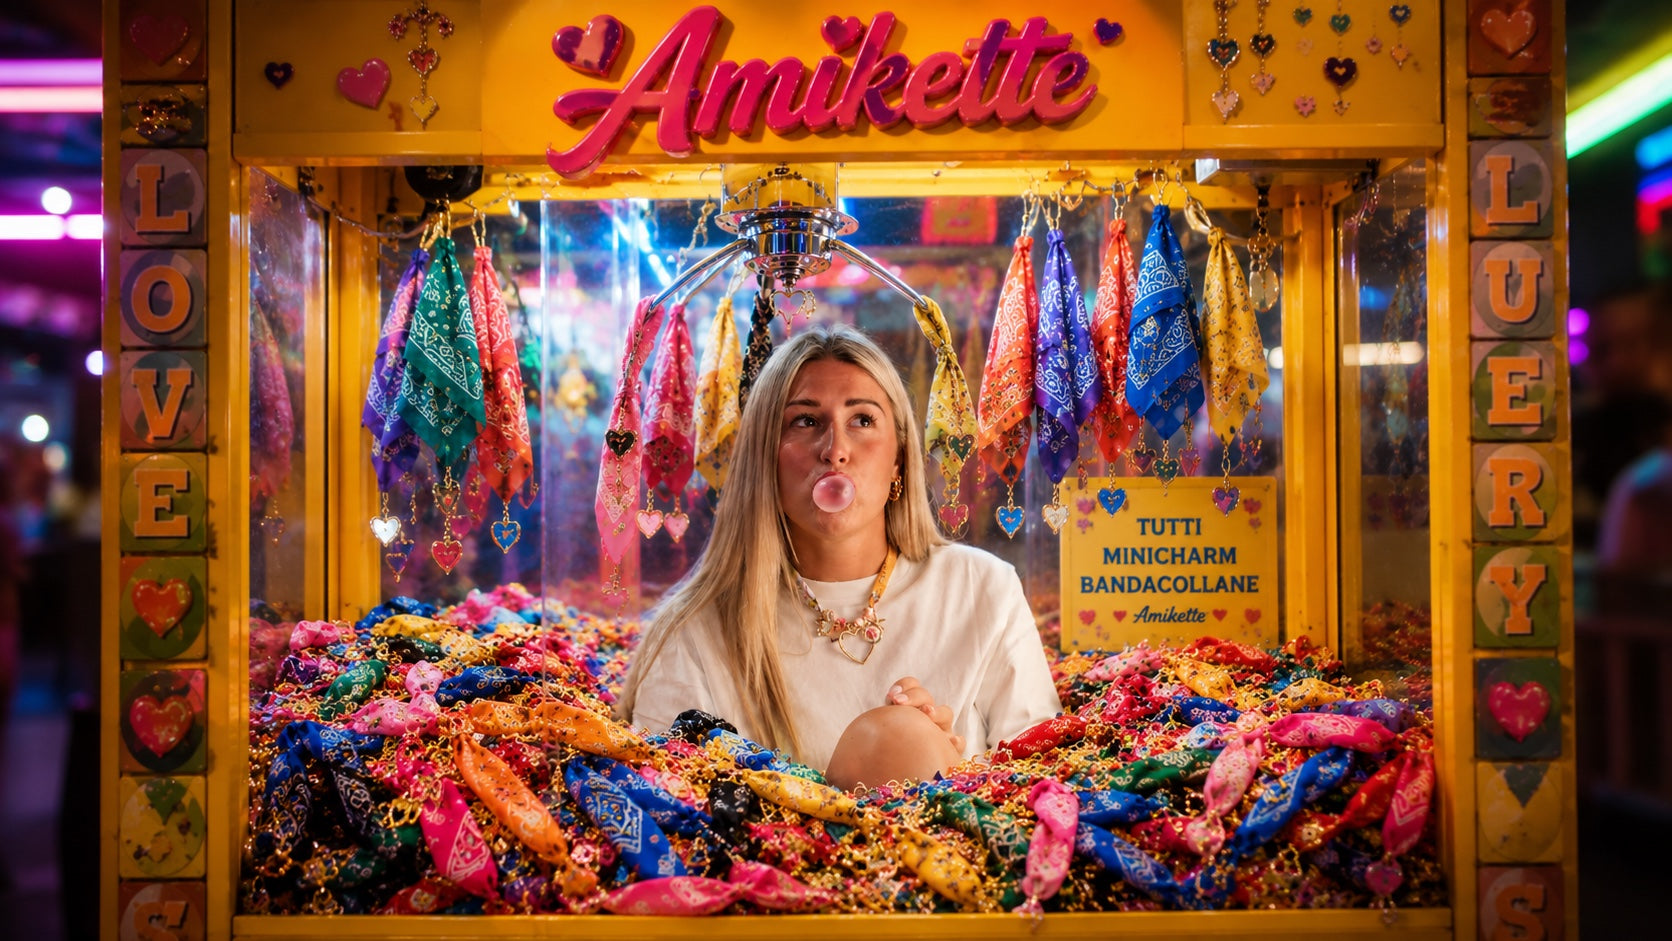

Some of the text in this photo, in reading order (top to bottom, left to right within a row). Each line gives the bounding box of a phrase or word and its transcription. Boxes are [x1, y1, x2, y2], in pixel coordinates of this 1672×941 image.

[545, 4, 1098, 180] Amikette
[131, 164, 192, 538] LOVE
[1484, 155, 1546, 635] LUERY
[1136, 517, 1202, 536] TUTTI
[1102, 546, 1237, 565] MINICHARM
[1080, 575, 1260, 594] BANDACOLLANE
[1132, 605, 1207, 624] Amikette
